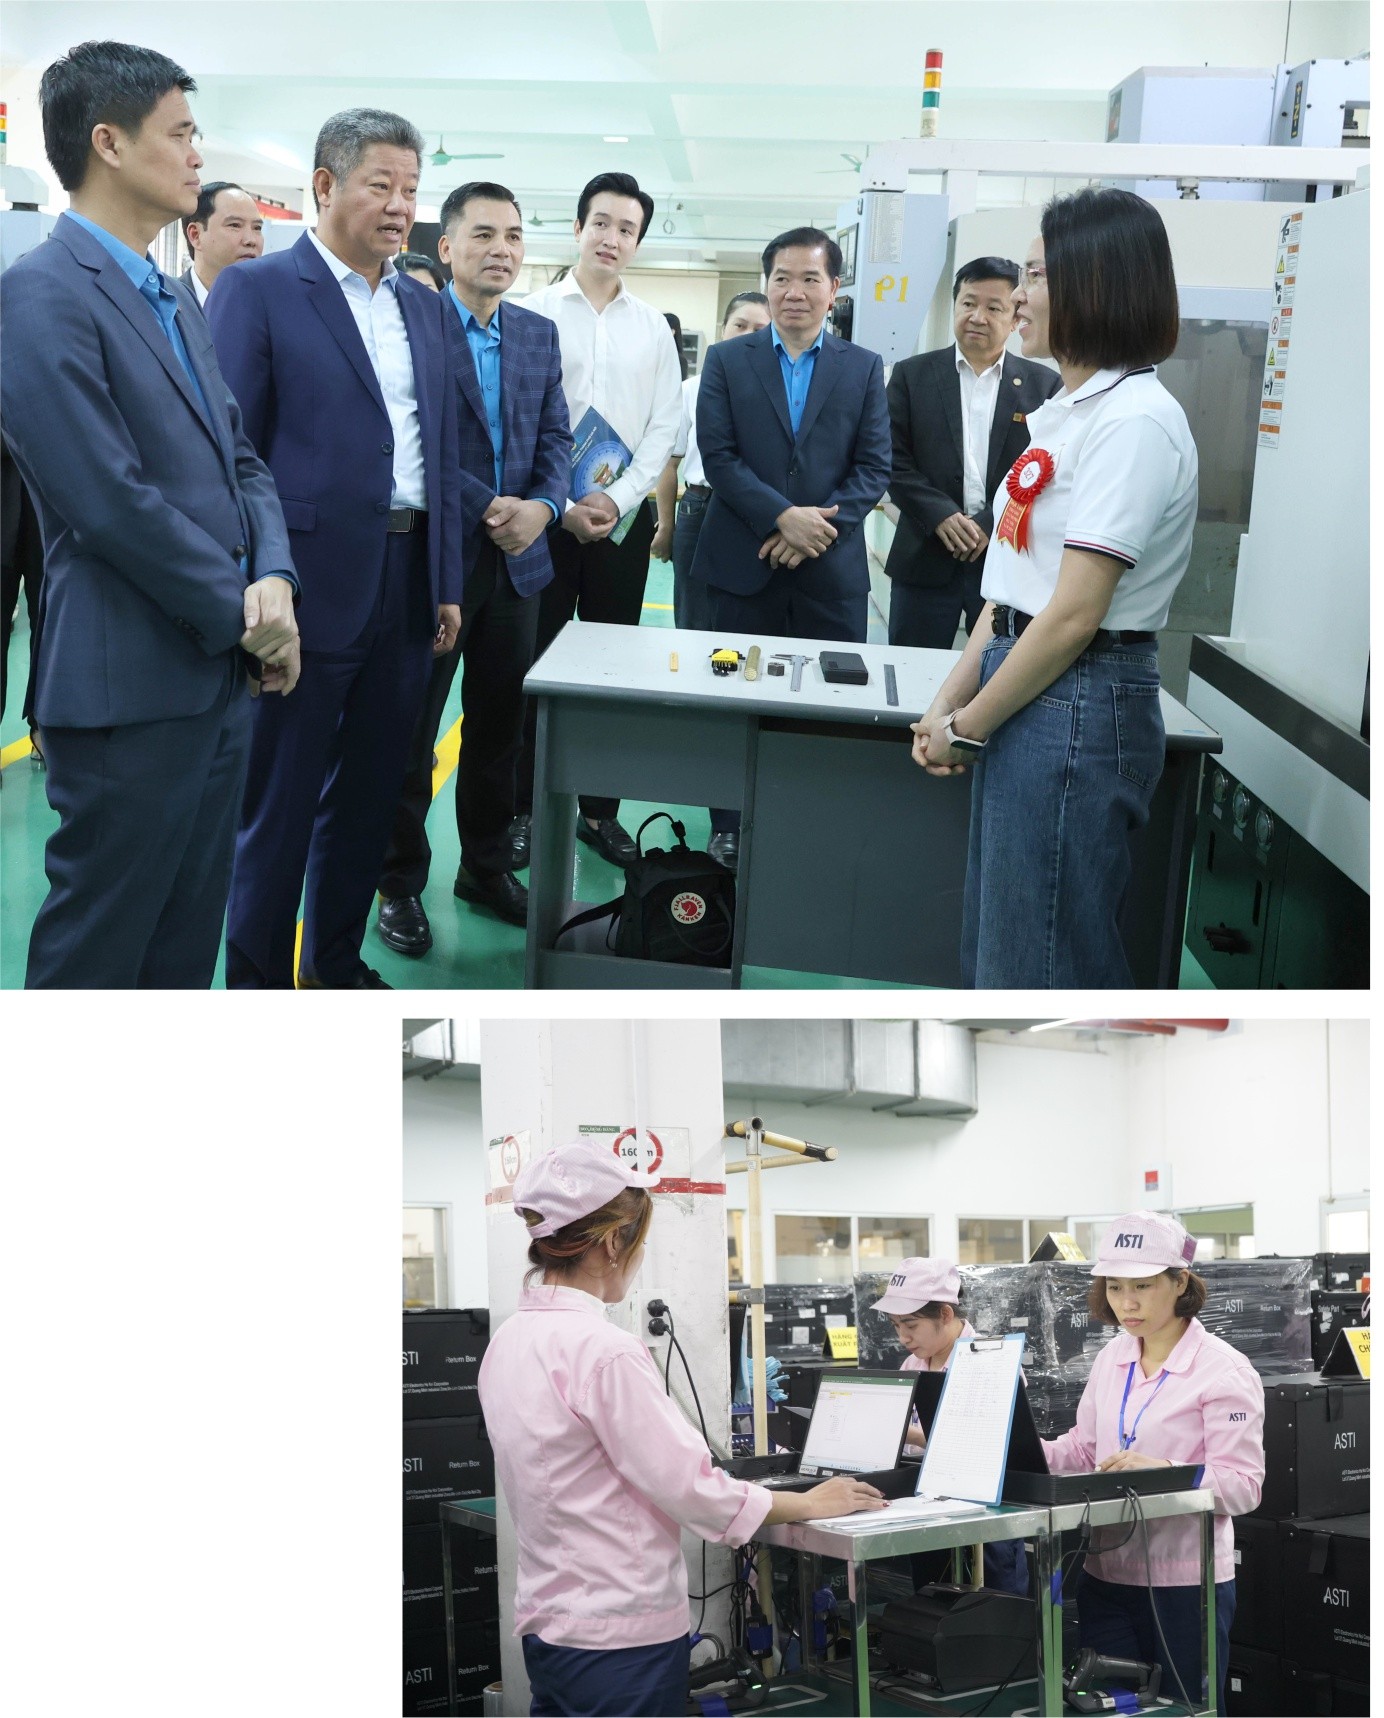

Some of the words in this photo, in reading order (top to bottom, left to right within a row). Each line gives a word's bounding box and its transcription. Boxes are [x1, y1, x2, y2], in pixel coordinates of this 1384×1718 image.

[1114, 1233, 1144, 1249] ASTI
[889, 1274, 906, 1287] STI
[1225, 1300, 1243, 1312] ASTI
[1070, 1313, 1089, 1328] ASTI
[465, 1355, 476, 1363] Box
[1229, 1413, 1247, 1421] ASTI
[1334, 1432, 1356, 1449] ASTI
[403, 1458, 422, 1472] STI
[449, 1461, 468, 1469] Return
[1323, 1587, 1349, 1607] ASTI
[406, 1667, 432, 1685] ASTI
